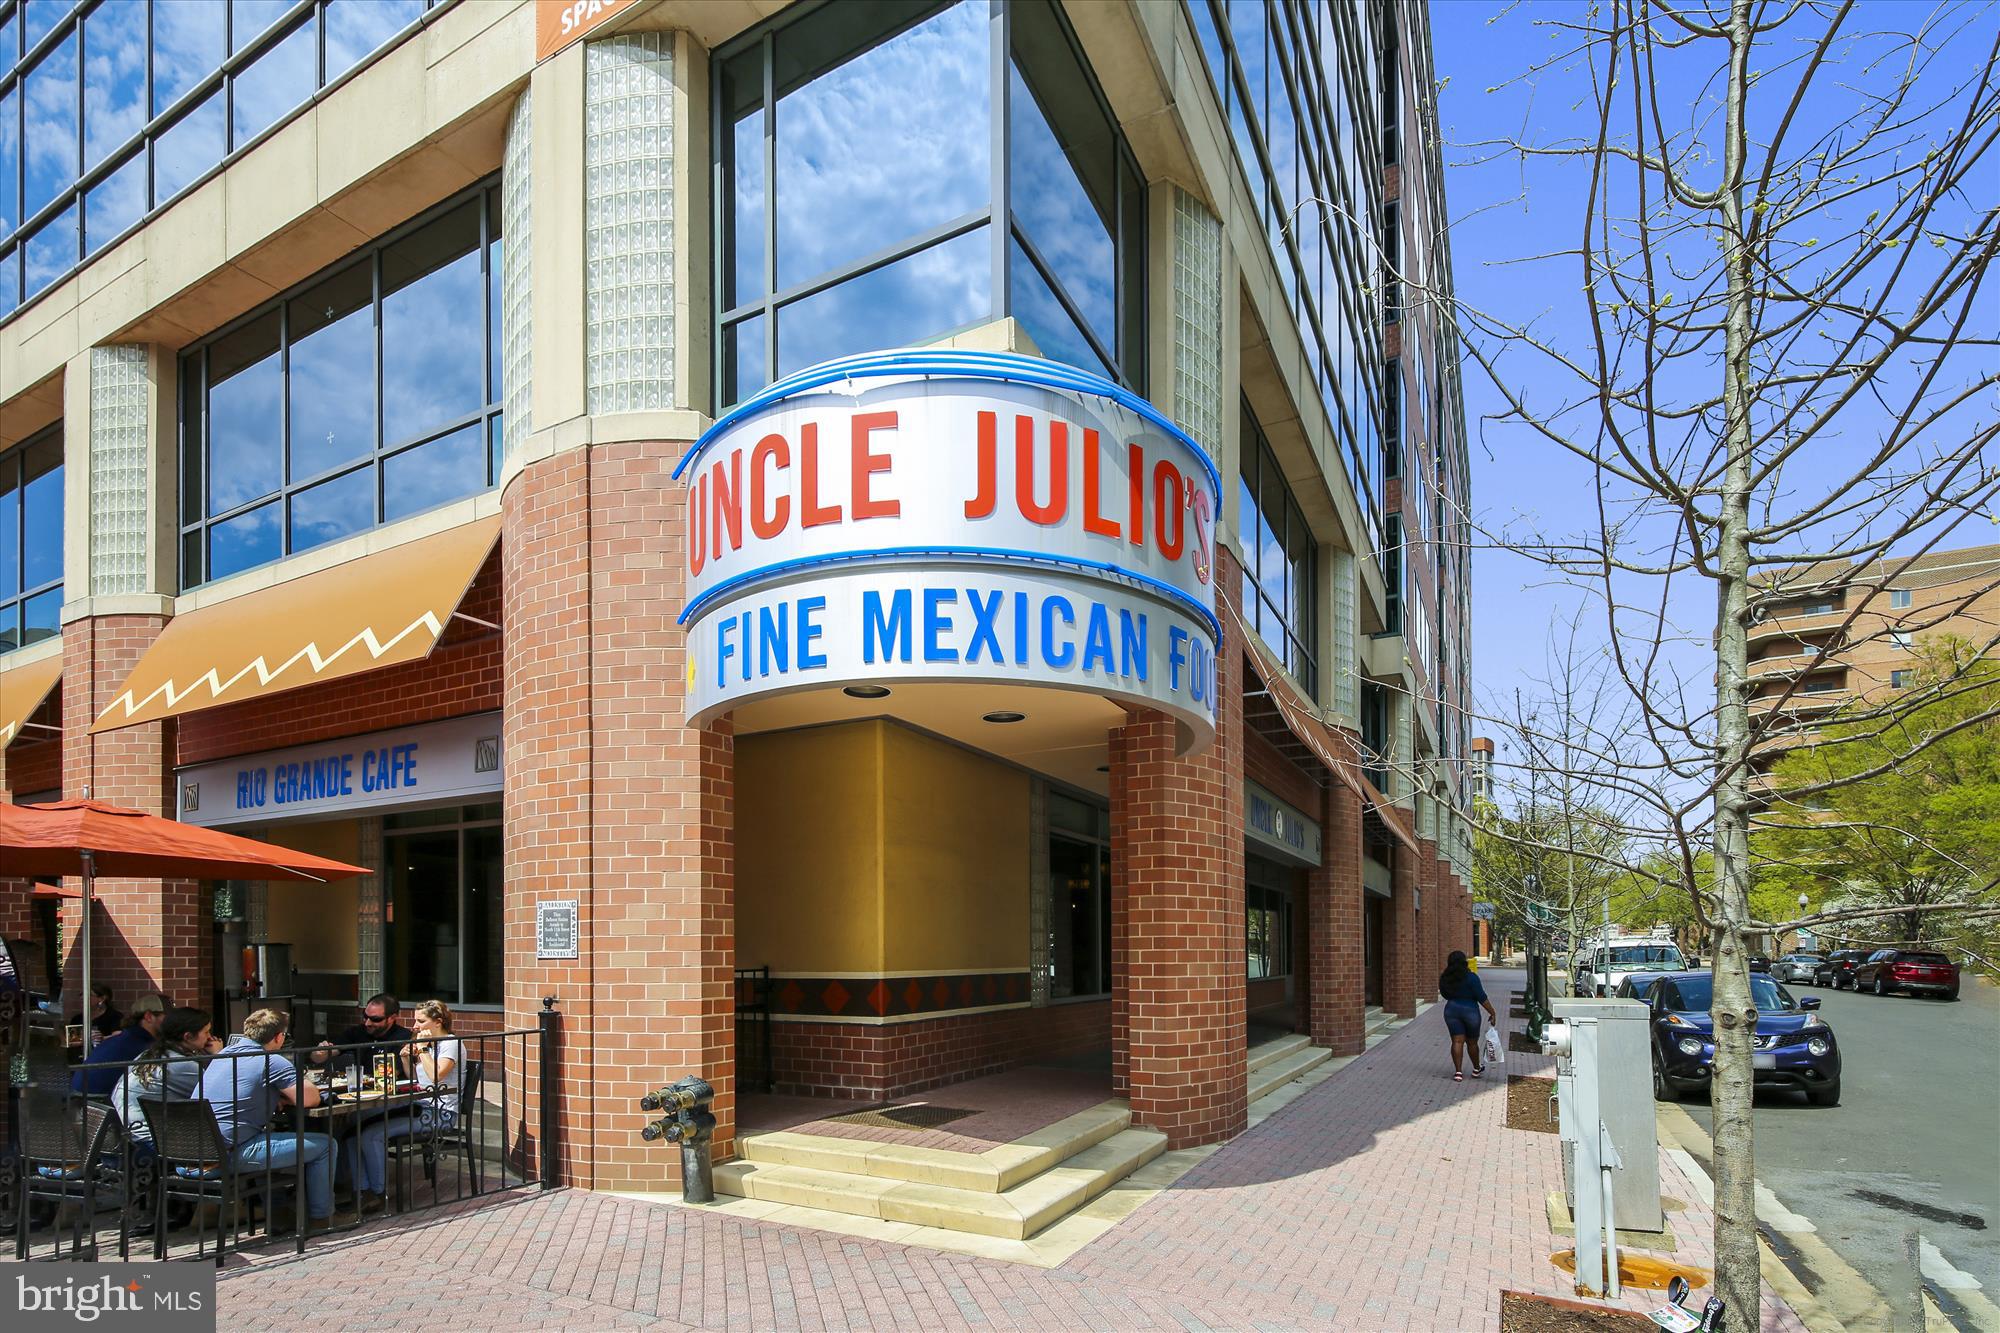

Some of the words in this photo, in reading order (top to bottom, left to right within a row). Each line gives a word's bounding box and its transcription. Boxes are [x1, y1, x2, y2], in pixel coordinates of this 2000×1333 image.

[561, 0, 616, 35] SPA
[689, 410, 901, 577] UNCLE
[964, 410, 1211, 586] JULIO'S
[717, 595, 828, 688] FINE
[863, 588, 1148, 682] MEXICAN
[1169, 624, 1217, 720] FOO
[236, 768, 267, 810] RIO
[274, 753, 354, 805] GRANDE
[361, 742, 419, 793] CAFE
